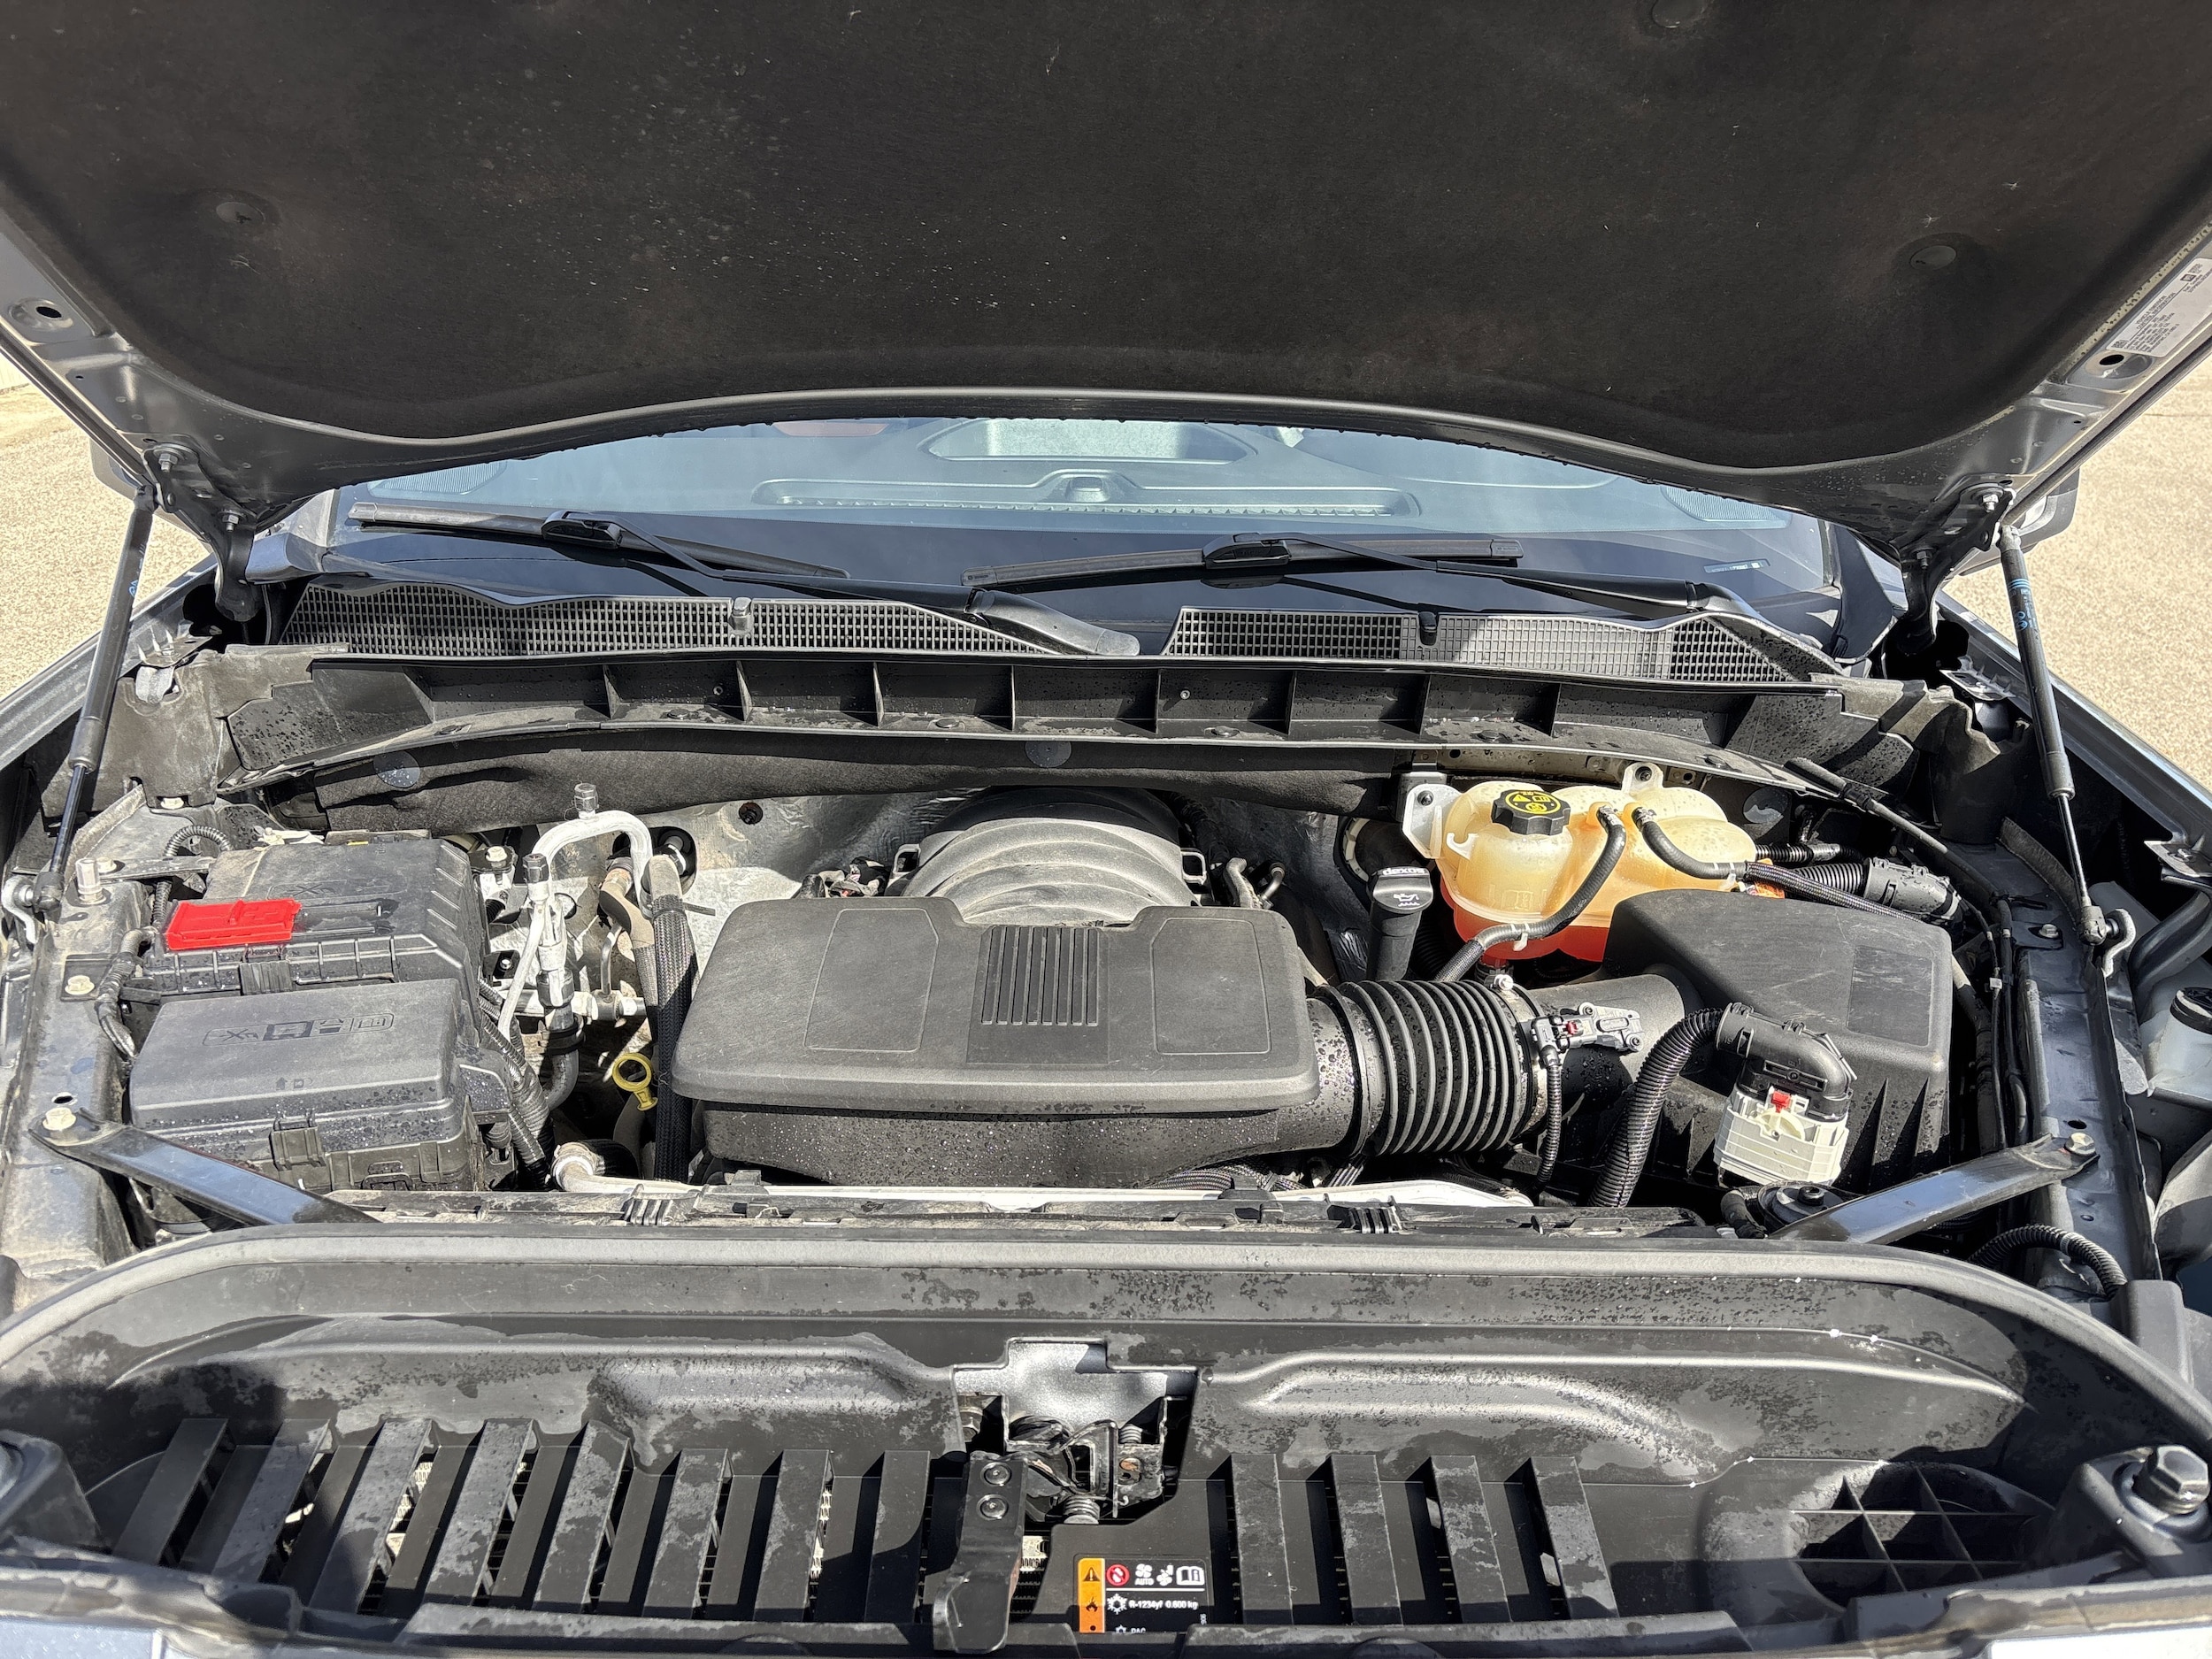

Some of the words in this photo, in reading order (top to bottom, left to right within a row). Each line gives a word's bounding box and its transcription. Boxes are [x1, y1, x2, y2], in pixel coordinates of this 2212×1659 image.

[1382, 867, 1425, 876] dexos
[1128, 1599, 1164, 1610] R-1234yf
[1187, 1599, 1199, 1610] kg
